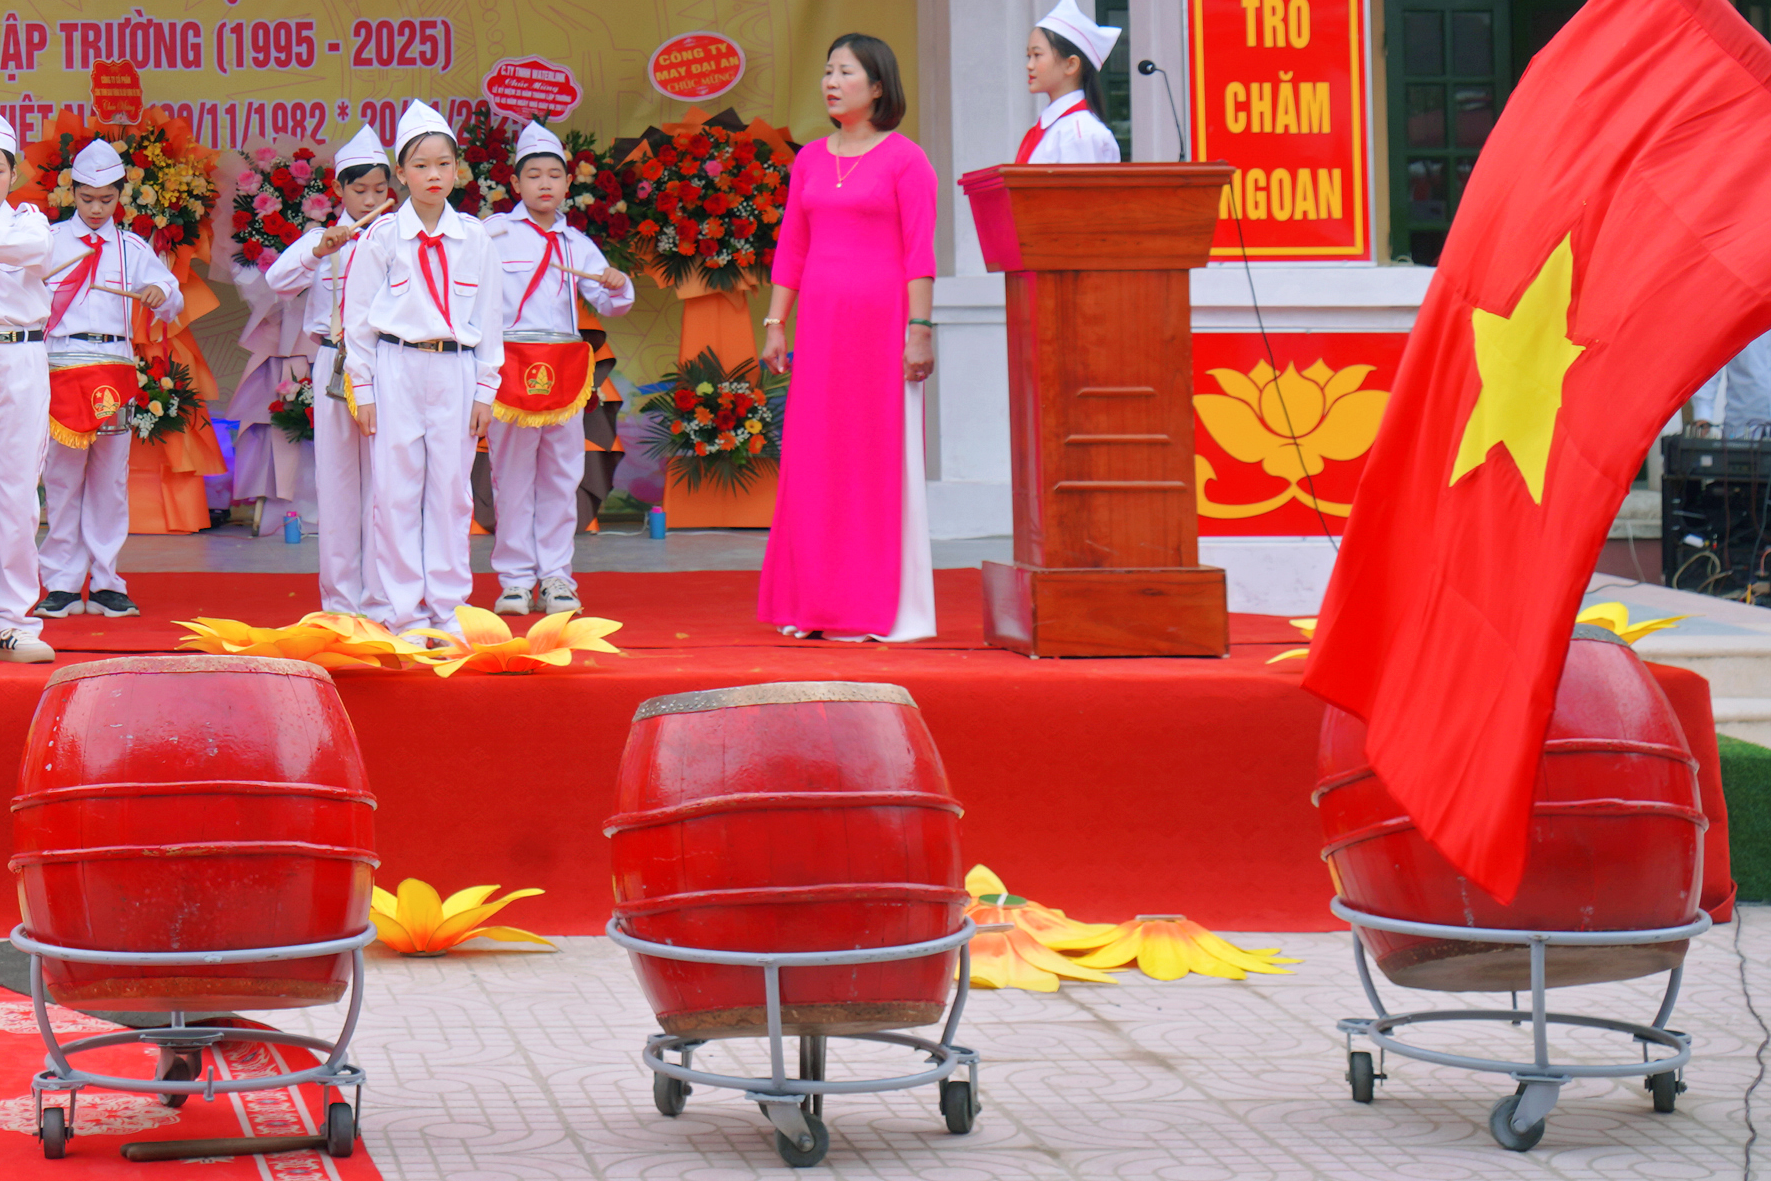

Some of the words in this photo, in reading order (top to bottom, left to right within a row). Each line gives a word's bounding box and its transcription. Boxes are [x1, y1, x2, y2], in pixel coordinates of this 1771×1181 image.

[59, 9, 202, 70] TRƯỜNG
[216, 21, 315, 74] (1995
[352, 19, 452, 72] 2025)
[655, 66, 686, 82] MAY
[691, 60, 716, 75] ĐẠI
[721, 56, 739, 68] AN
[659, 48, 704, 65] CÔNG
[708, 42, 727, 55] TY
[1224, 70, 1331, 134] CHĂM
[1218, 167, 1343, 222] NGOAN
